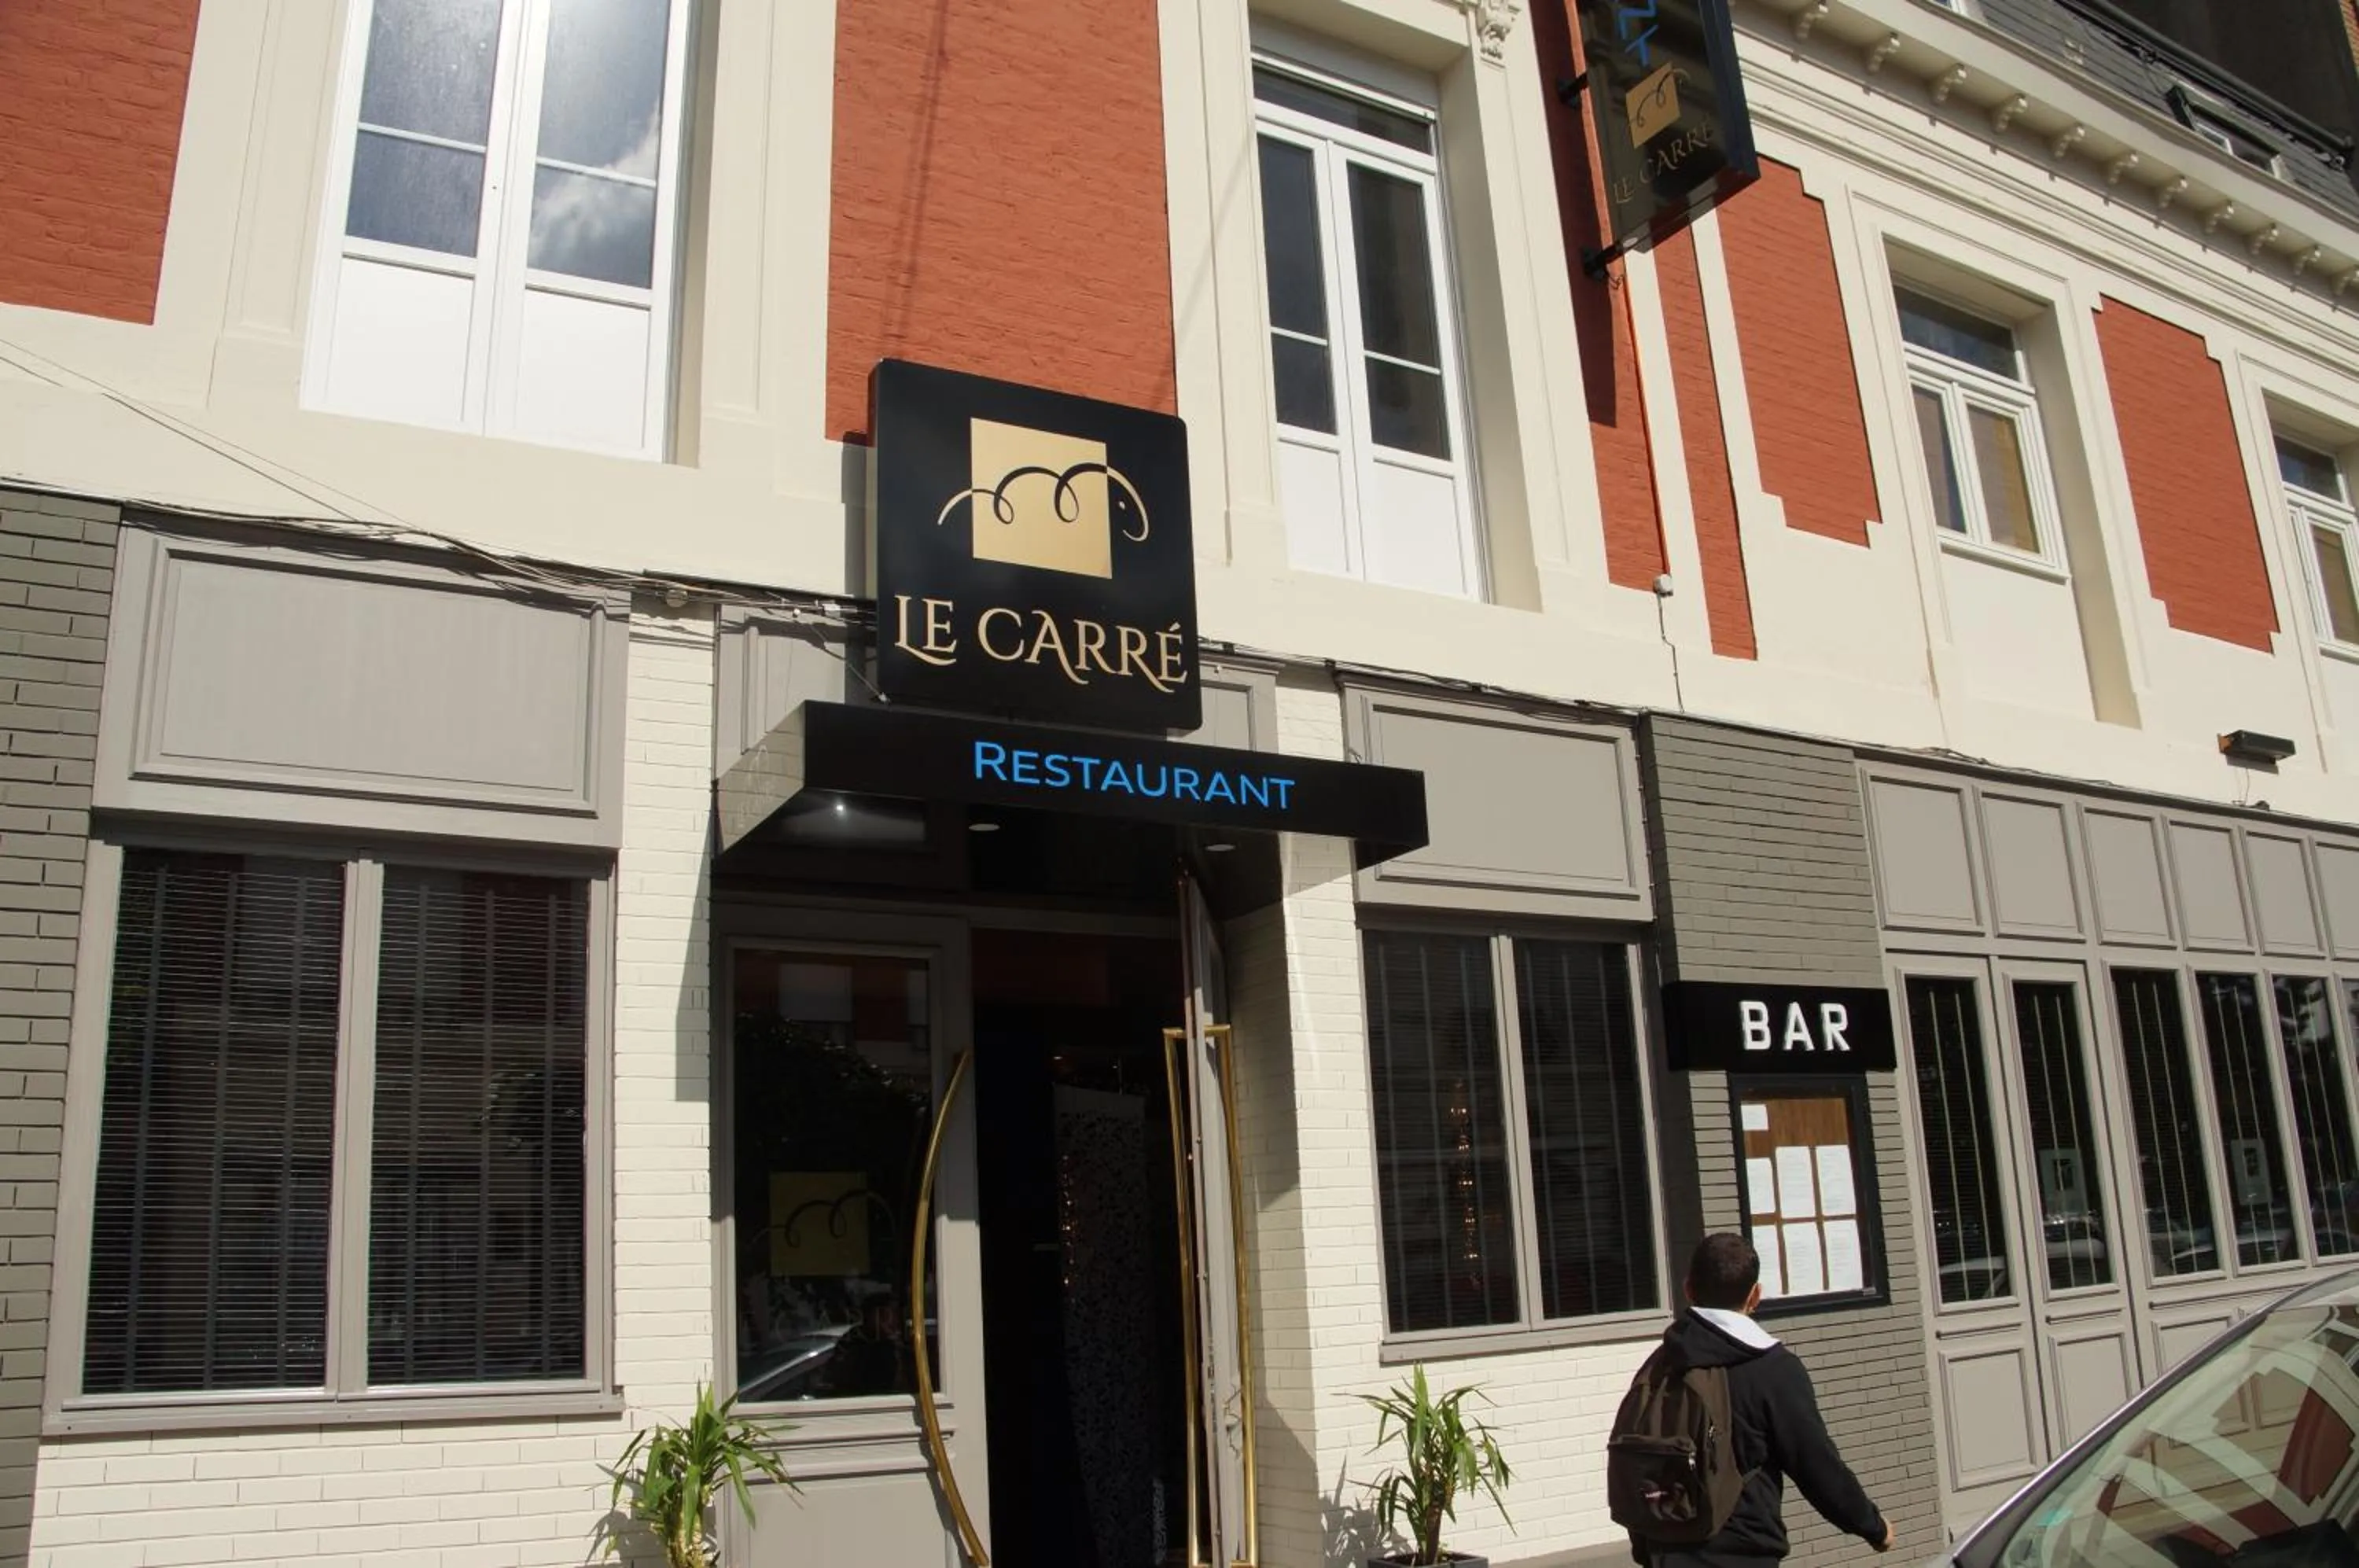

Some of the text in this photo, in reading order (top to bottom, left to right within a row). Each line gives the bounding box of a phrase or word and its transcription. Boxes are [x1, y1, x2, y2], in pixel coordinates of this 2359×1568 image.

[1613, 178, 1635, 204] LE
[894, 594, 1187, 693] LE CARRÉ
[974, 741, 1296, 810] RESTAURANT
[1739, 1000, 1851, 1052] BAR
